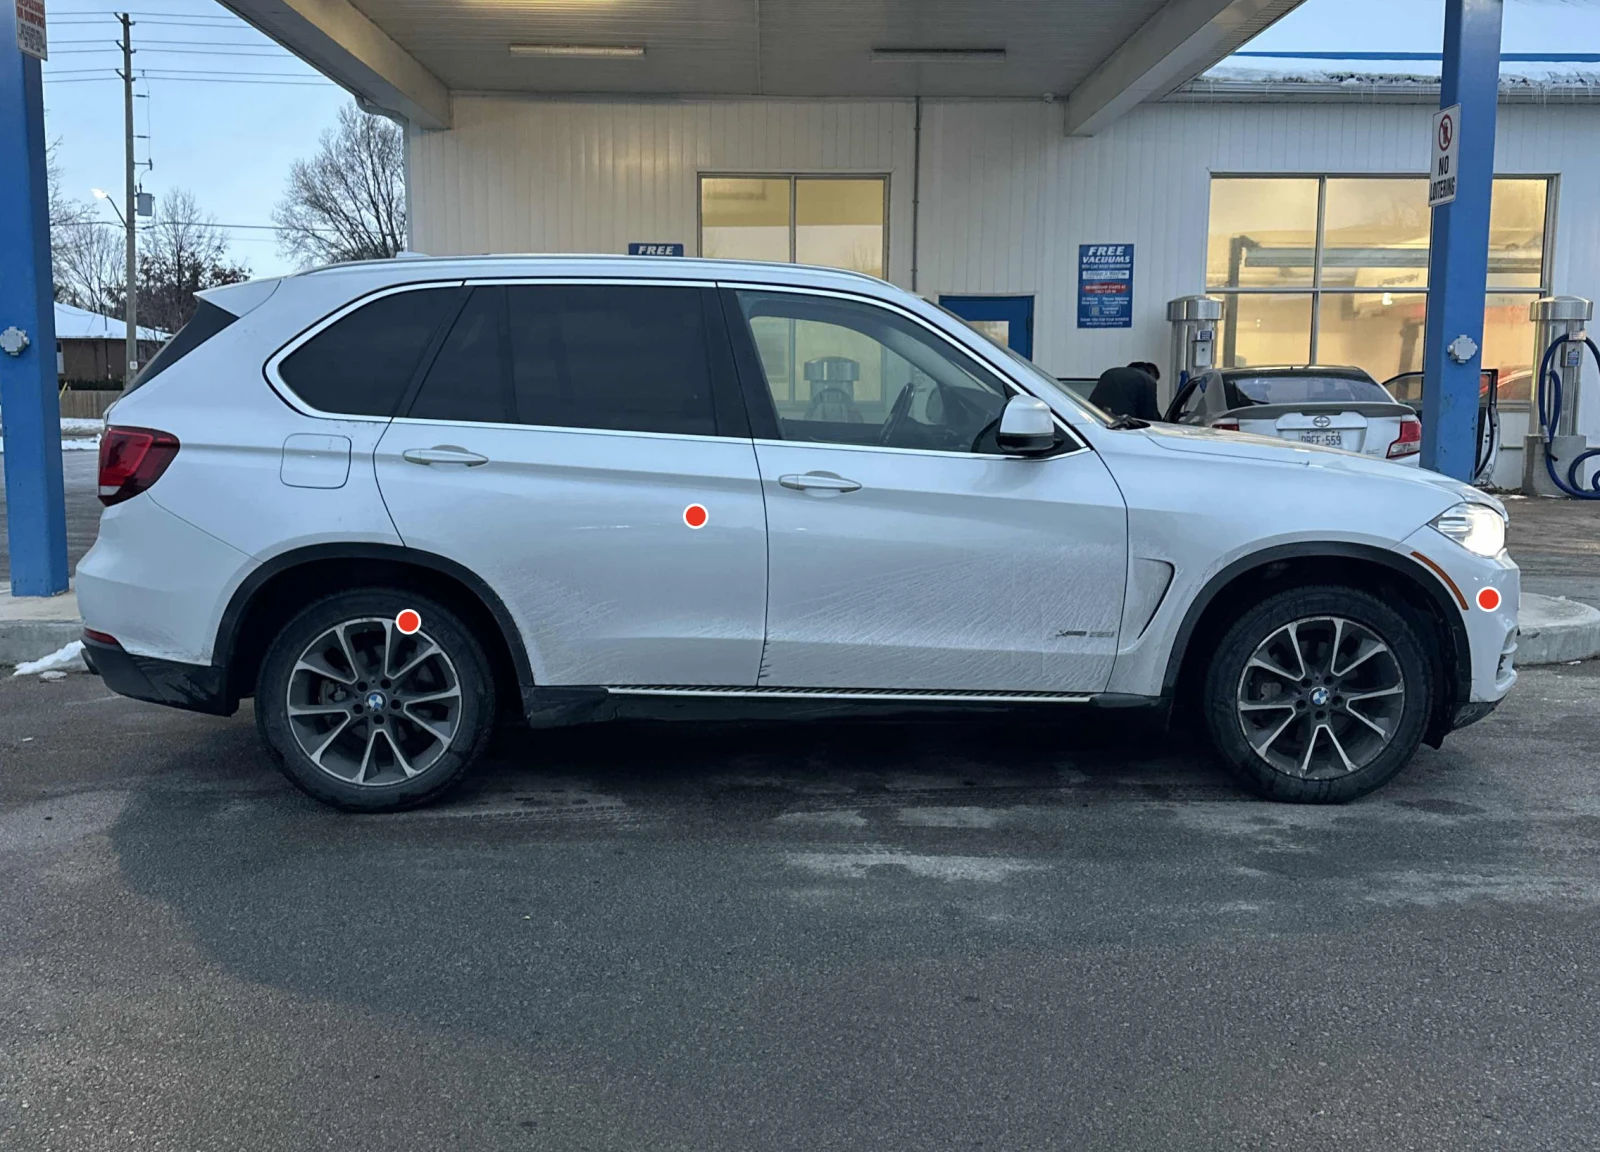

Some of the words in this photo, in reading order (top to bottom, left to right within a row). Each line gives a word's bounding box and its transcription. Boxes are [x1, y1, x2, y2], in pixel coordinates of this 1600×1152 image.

[1438, 155, 1449, 176] NO
[1430, 176, 1455, 201] LOITERING
[638, 245, 674, 255] FREE
[1088, 246, 1125, 256] FREE
[1082, 256, 1130, 264] VACUUMS
